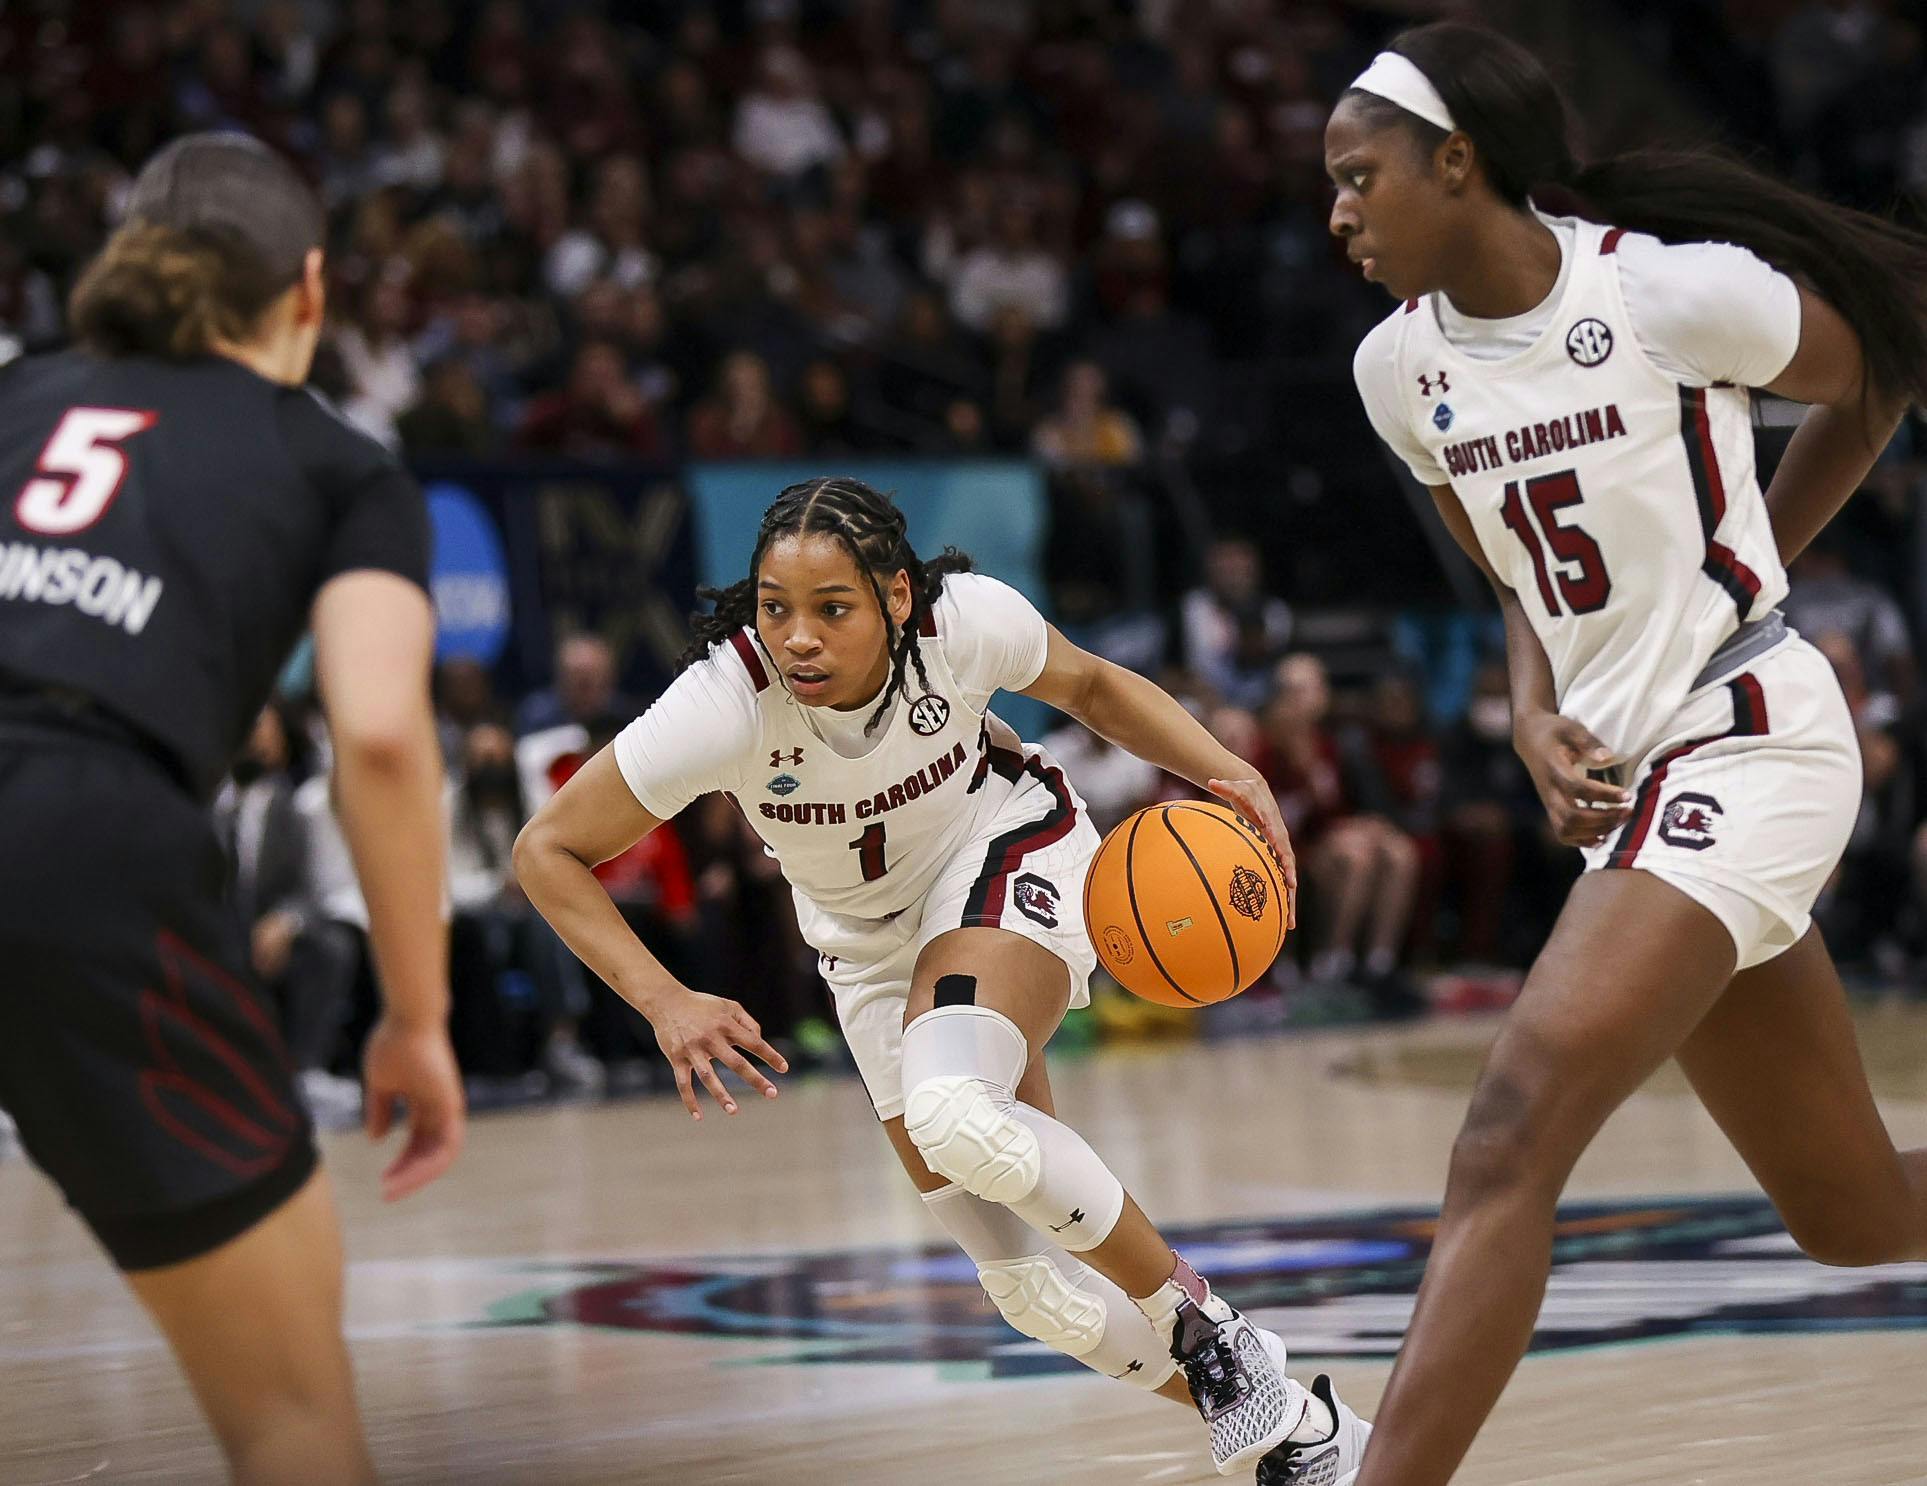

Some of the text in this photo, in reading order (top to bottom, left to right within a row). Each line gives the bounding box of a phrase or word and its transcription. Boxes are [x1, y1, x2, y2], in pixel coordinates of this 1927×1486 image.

[1568, 321, 1610, 363] SEC
[13, 403, 160, 536] 5
[1443, 404, 1627, 477] SOUTH CAROLINA
[1499, 468, 1611, 617] 15
[0, 541, 163, 635] INSON
[912, 697, 948, 733] SEC
[759, 741, 967, 825] SOUTH CAROLINA
[848, 821, 888, 882] 1
[1235, 868, 1261, 918] FINAL FOUR
